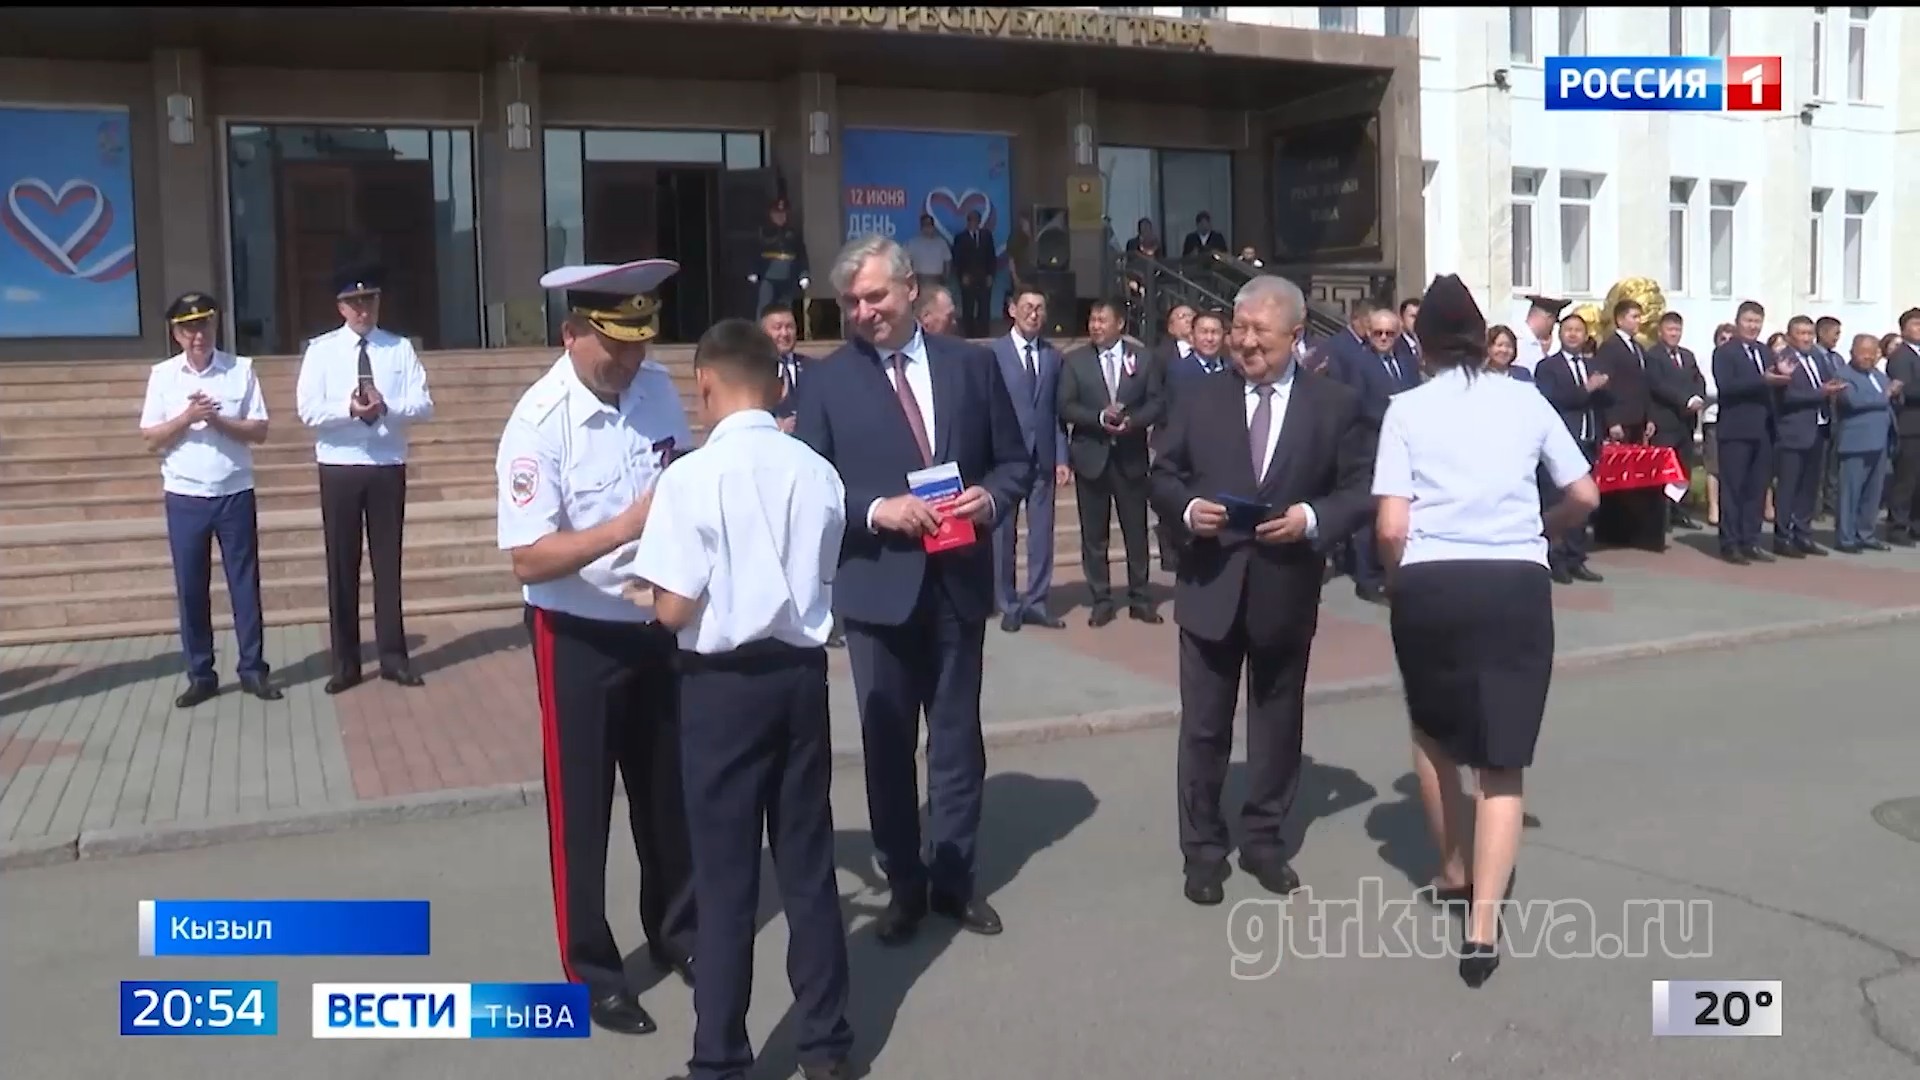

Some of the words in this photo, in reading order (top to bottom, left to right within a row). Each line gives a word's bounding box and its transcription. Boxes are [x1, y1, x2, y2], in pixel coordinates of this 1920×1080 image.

[897, 7, 1117, 42] РЕСПУБЛИКИ
[1117, 17, 1211, 51] ТЫВА
[850, 188, 864, 204] 12
[866, 189, 905, 207] ИЮНЯ
[847, 213, 897, 239] ДЕНЬ
